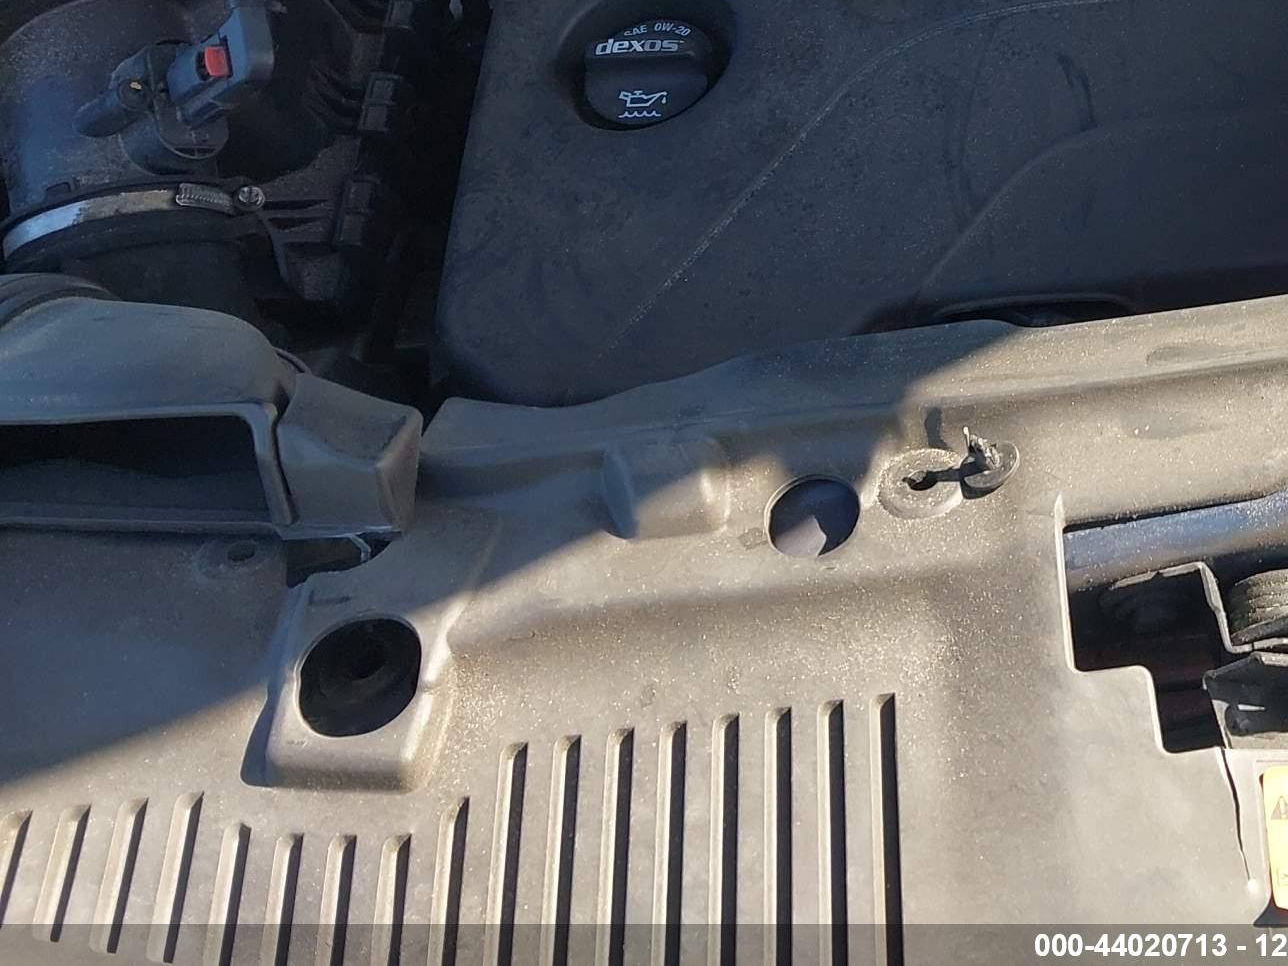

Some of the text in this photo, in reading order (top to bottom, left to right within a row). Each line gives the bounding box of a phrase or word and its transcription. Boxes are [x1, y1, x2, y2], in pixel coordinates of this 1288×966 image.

[624, 22, 691, 37] SAE 0W-20
[595, 38, 679, 55] dexos
